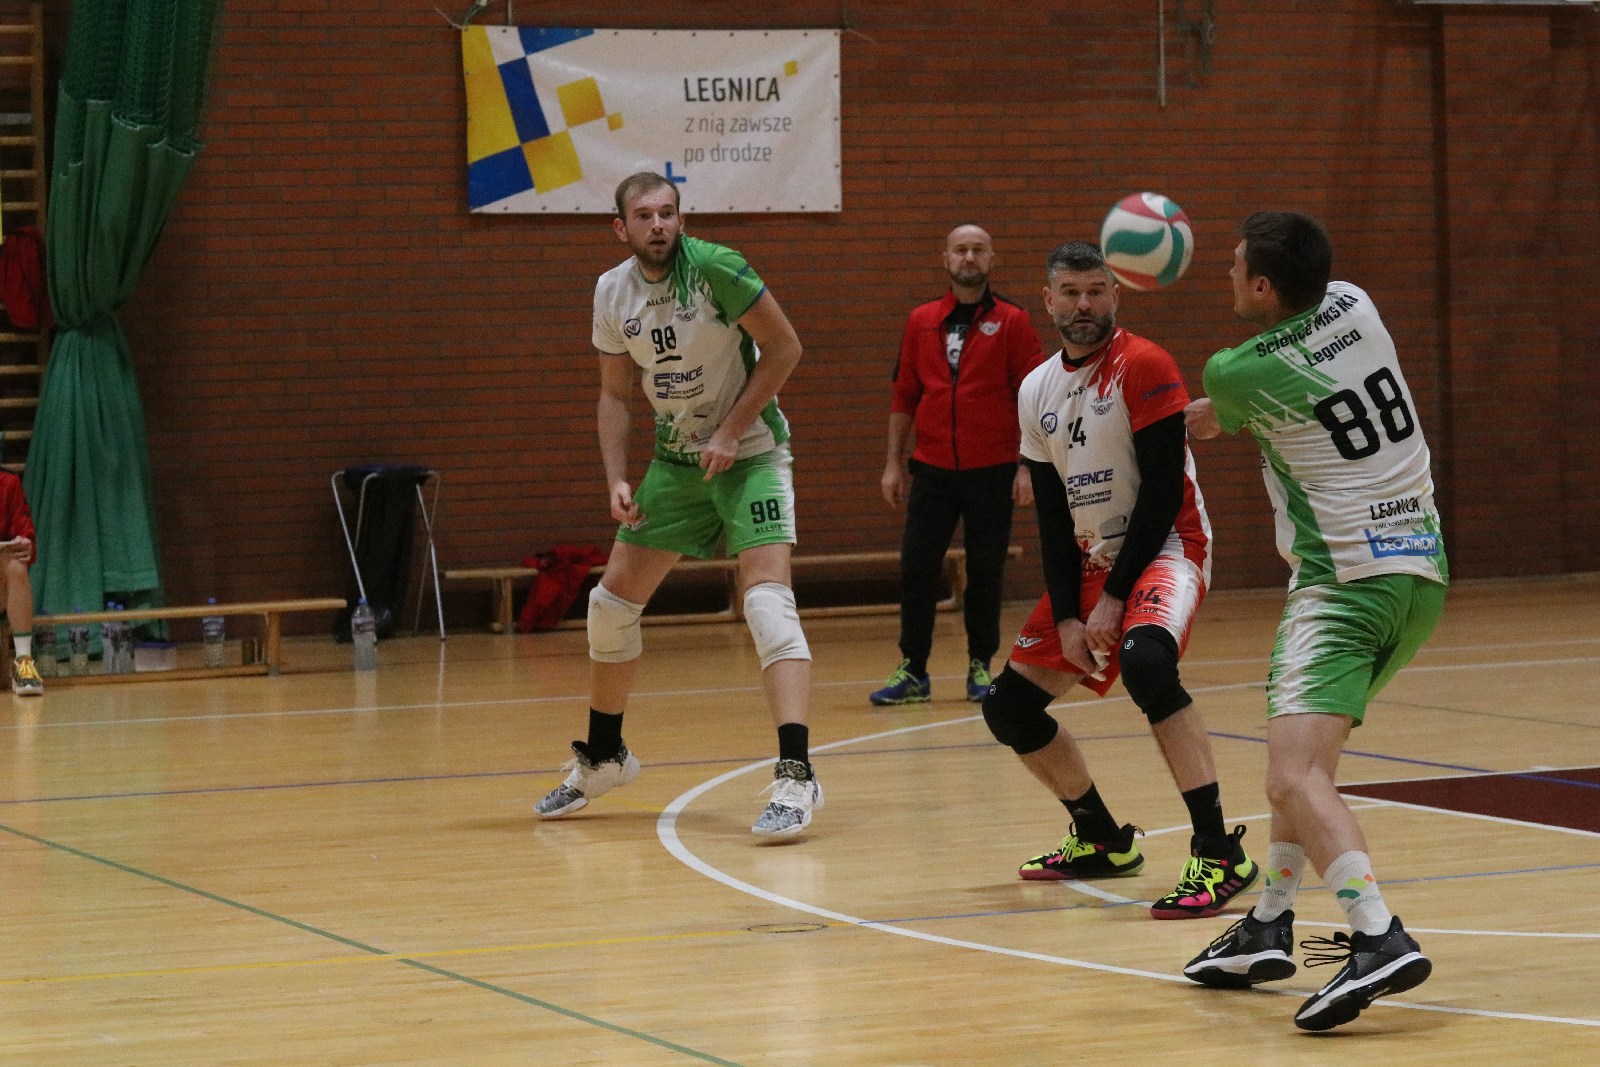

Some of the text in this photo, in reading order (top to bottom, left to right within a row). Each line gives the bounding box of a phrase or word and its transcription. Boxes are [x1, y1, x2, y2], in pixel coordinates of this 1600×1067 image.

[684, 77, 780, 102] LEGNICA
[685, 113, 792, 136] z nią zawsze
[684, 142, 773, 169] po drodze
[651, 325, 677, 354] 98
[1256, 324, 1313, 357] Science
[1314, 305, 1341, 331] MKS
[1303, 329, 1363, 367] Legnica
[1313, 366, 1415, 461] 88
[750, 498, 780, 524] 98
[1134, 586, 1162, 609] 24
